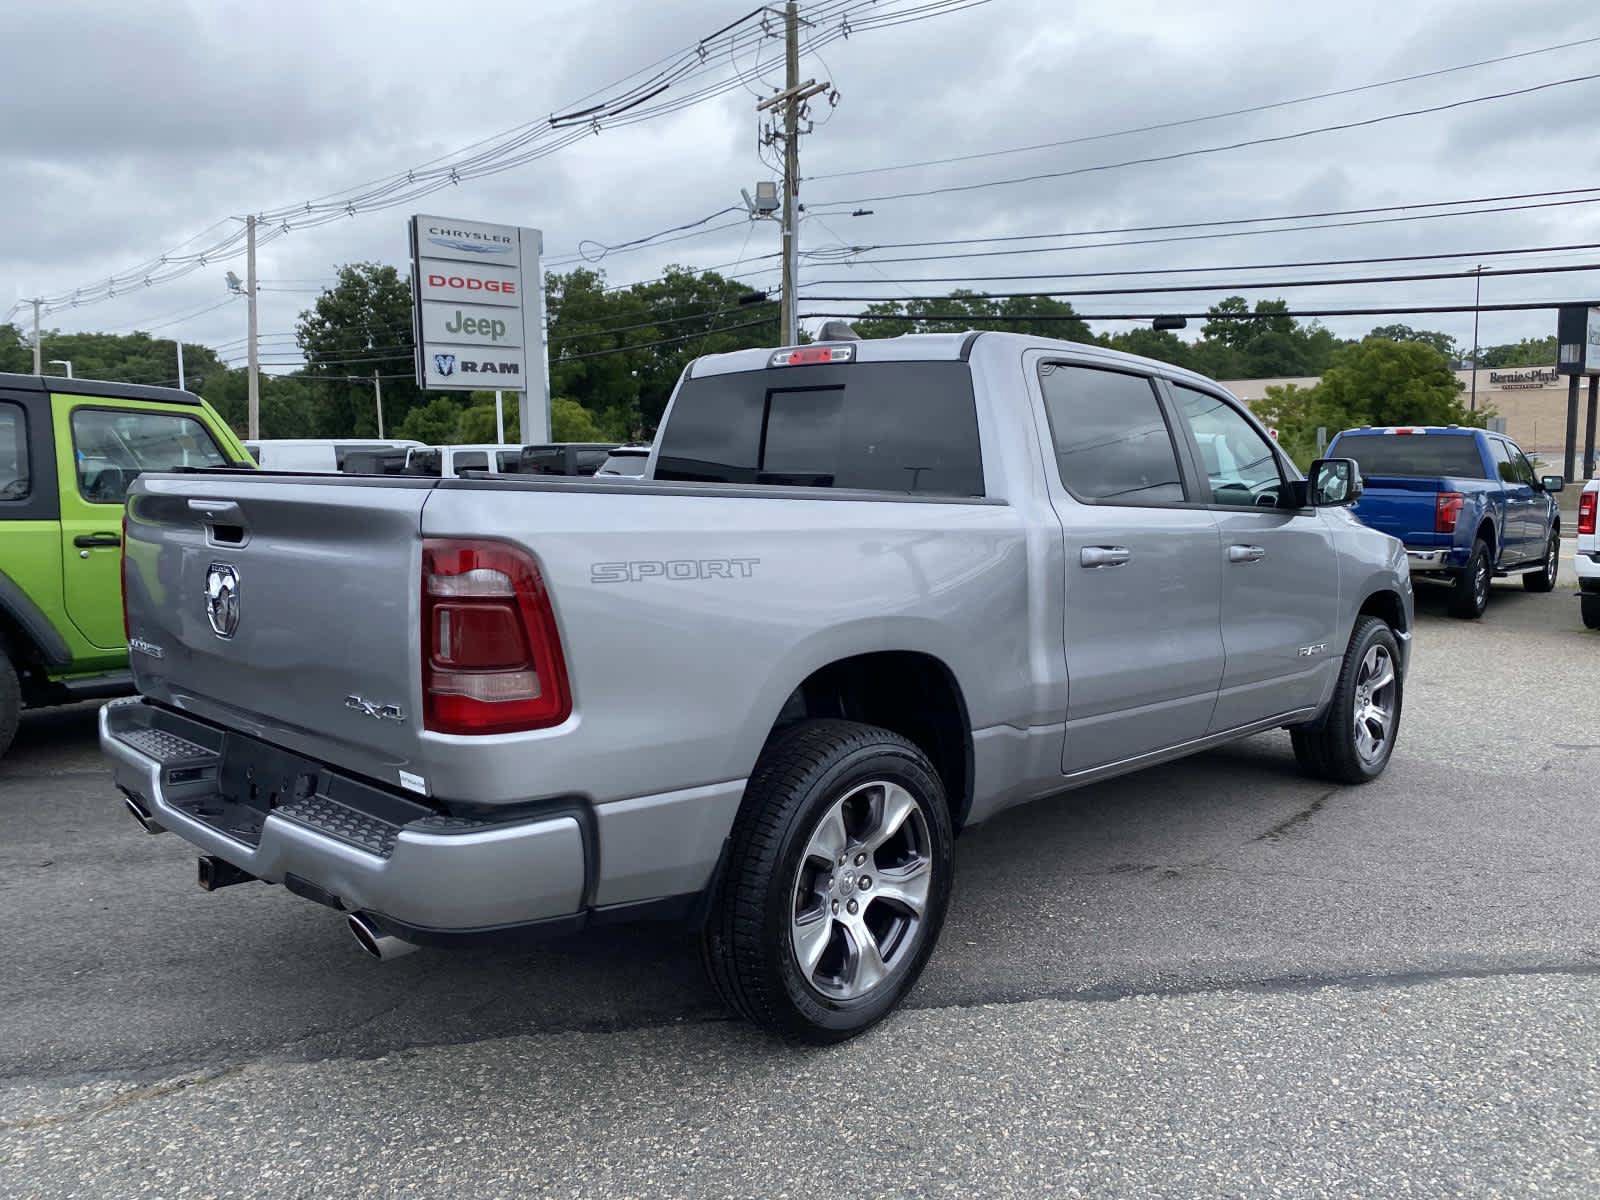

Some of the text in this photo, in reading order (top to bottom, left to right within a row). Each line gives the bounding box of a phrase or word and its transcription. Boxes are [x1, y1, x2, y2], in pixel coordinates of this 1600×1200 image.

[429, 227, 511, 244] CHRYSLER
[428, 275, 516, 294] DODGE
[445, 311, 506, 341] Jeep
[460, 361, 520, 374] RAM
[591, 558, 761, 583] SPORT
